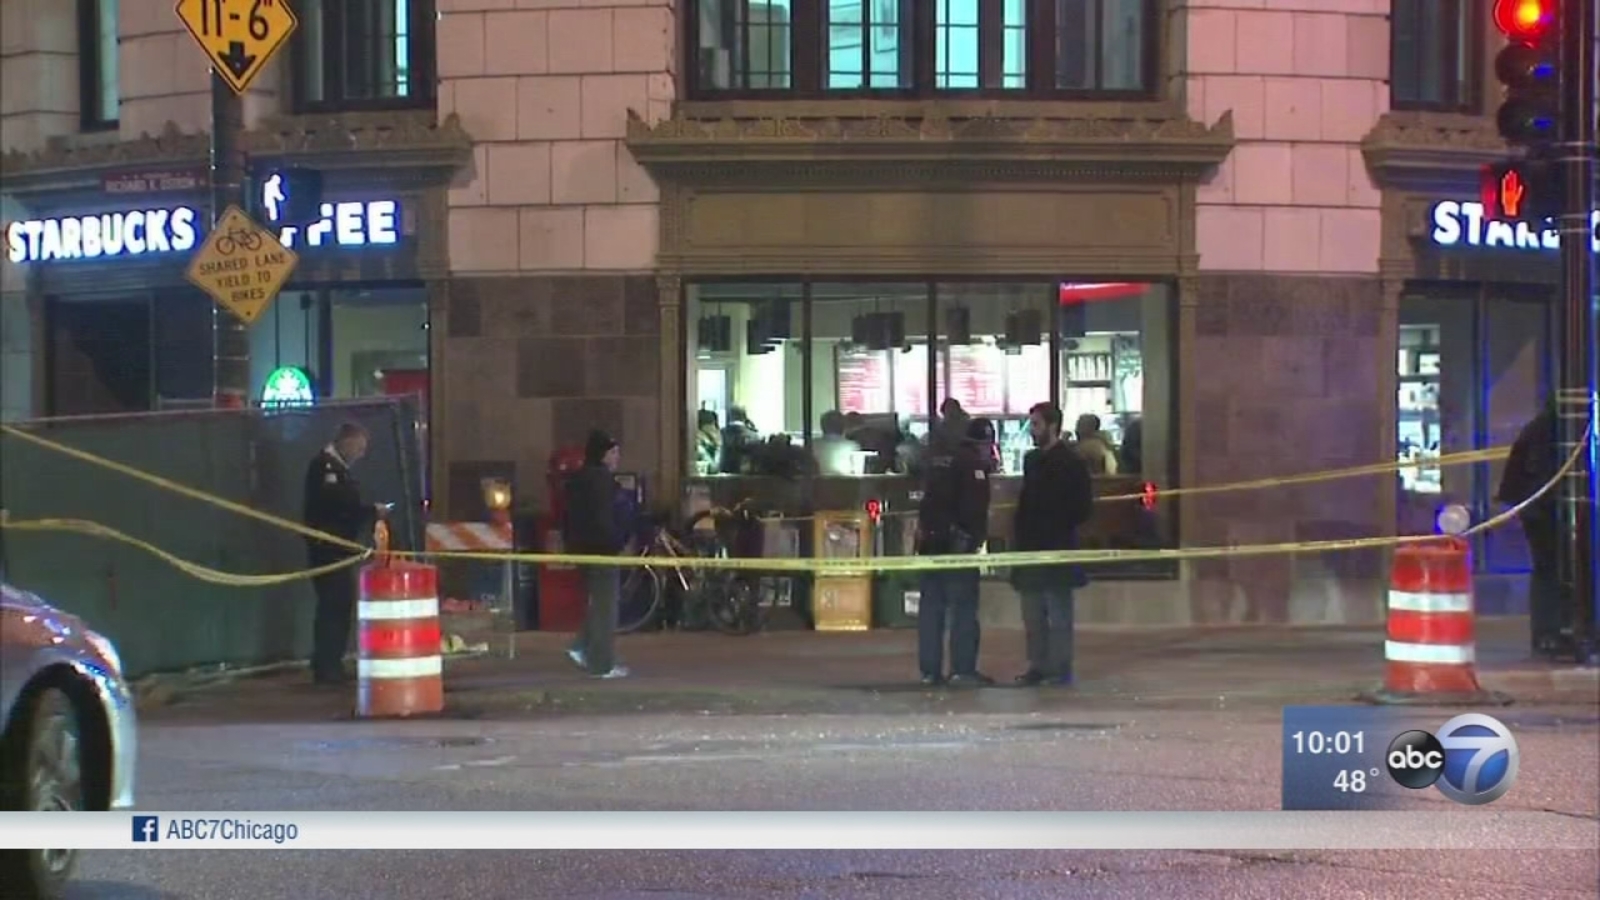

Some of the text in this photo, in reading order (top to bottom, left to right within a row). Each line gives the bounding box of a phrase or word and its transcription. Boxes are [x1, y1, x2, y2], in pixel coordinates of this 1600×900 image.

[8, 206, 196, 263] STARBUCKS
[199, 252, 286, 276] SHARED LANE
[216, 269, 271, 288] YIELD TO
[231, 288, 266, 302] BIKES
